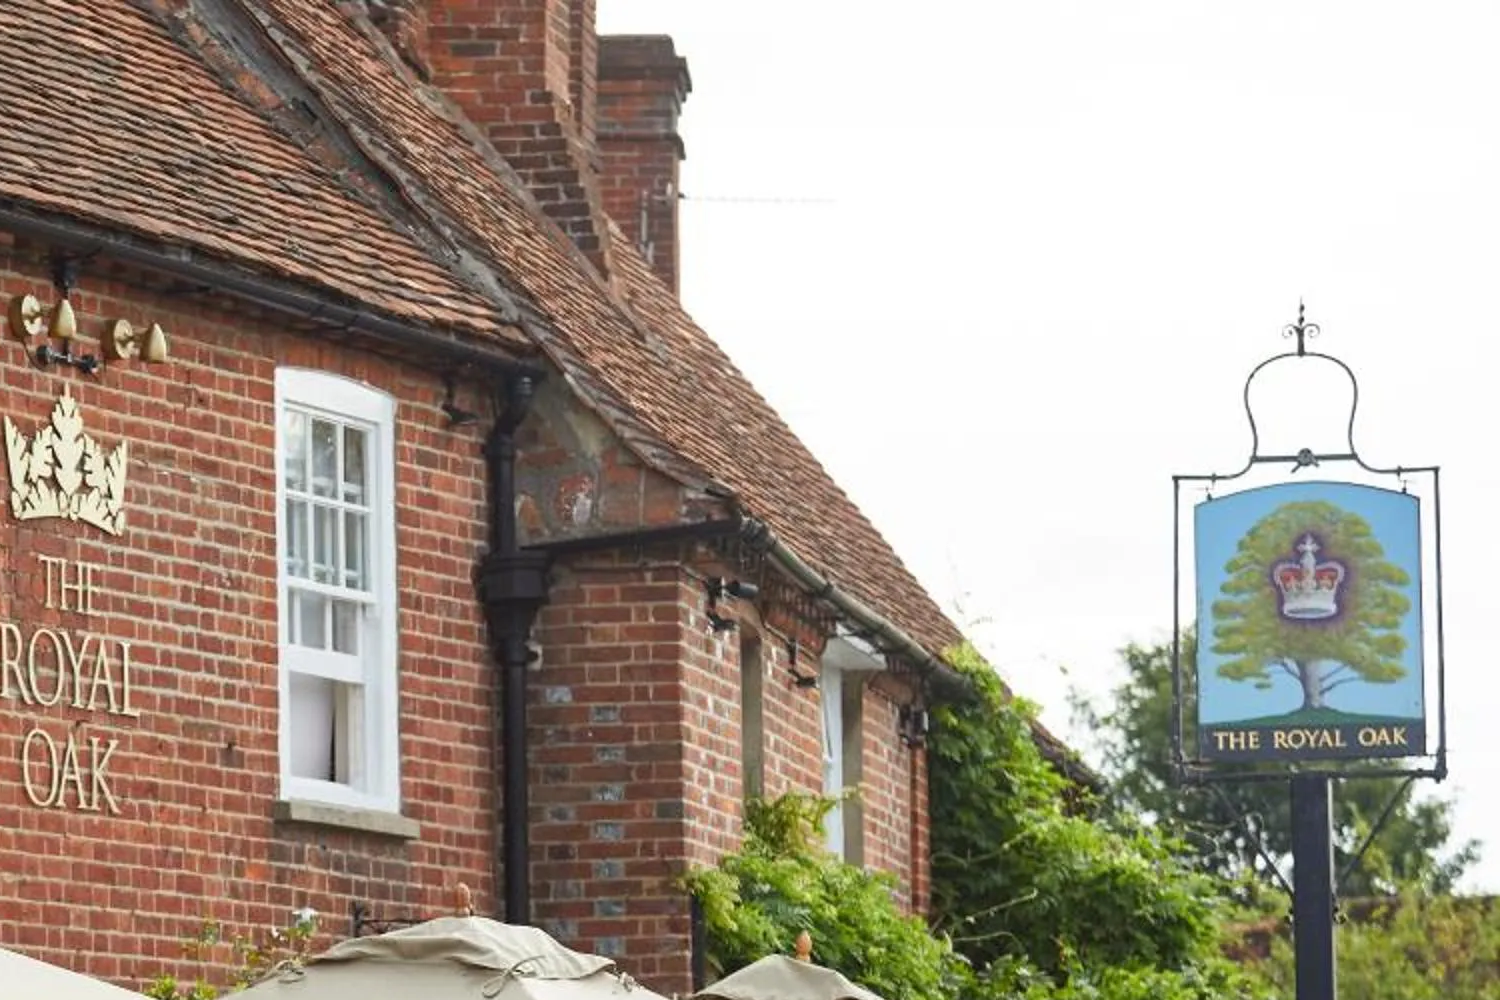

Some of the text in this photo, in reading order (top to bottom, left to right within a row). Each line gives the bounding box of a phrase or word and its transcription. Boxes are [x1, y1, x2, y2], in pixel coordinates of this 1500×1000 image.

[38, 553, 101, 616] THE
[1213, 726, 1409, 750] THE ROYAL OAK
[23, 728, 122, 815] OAK
